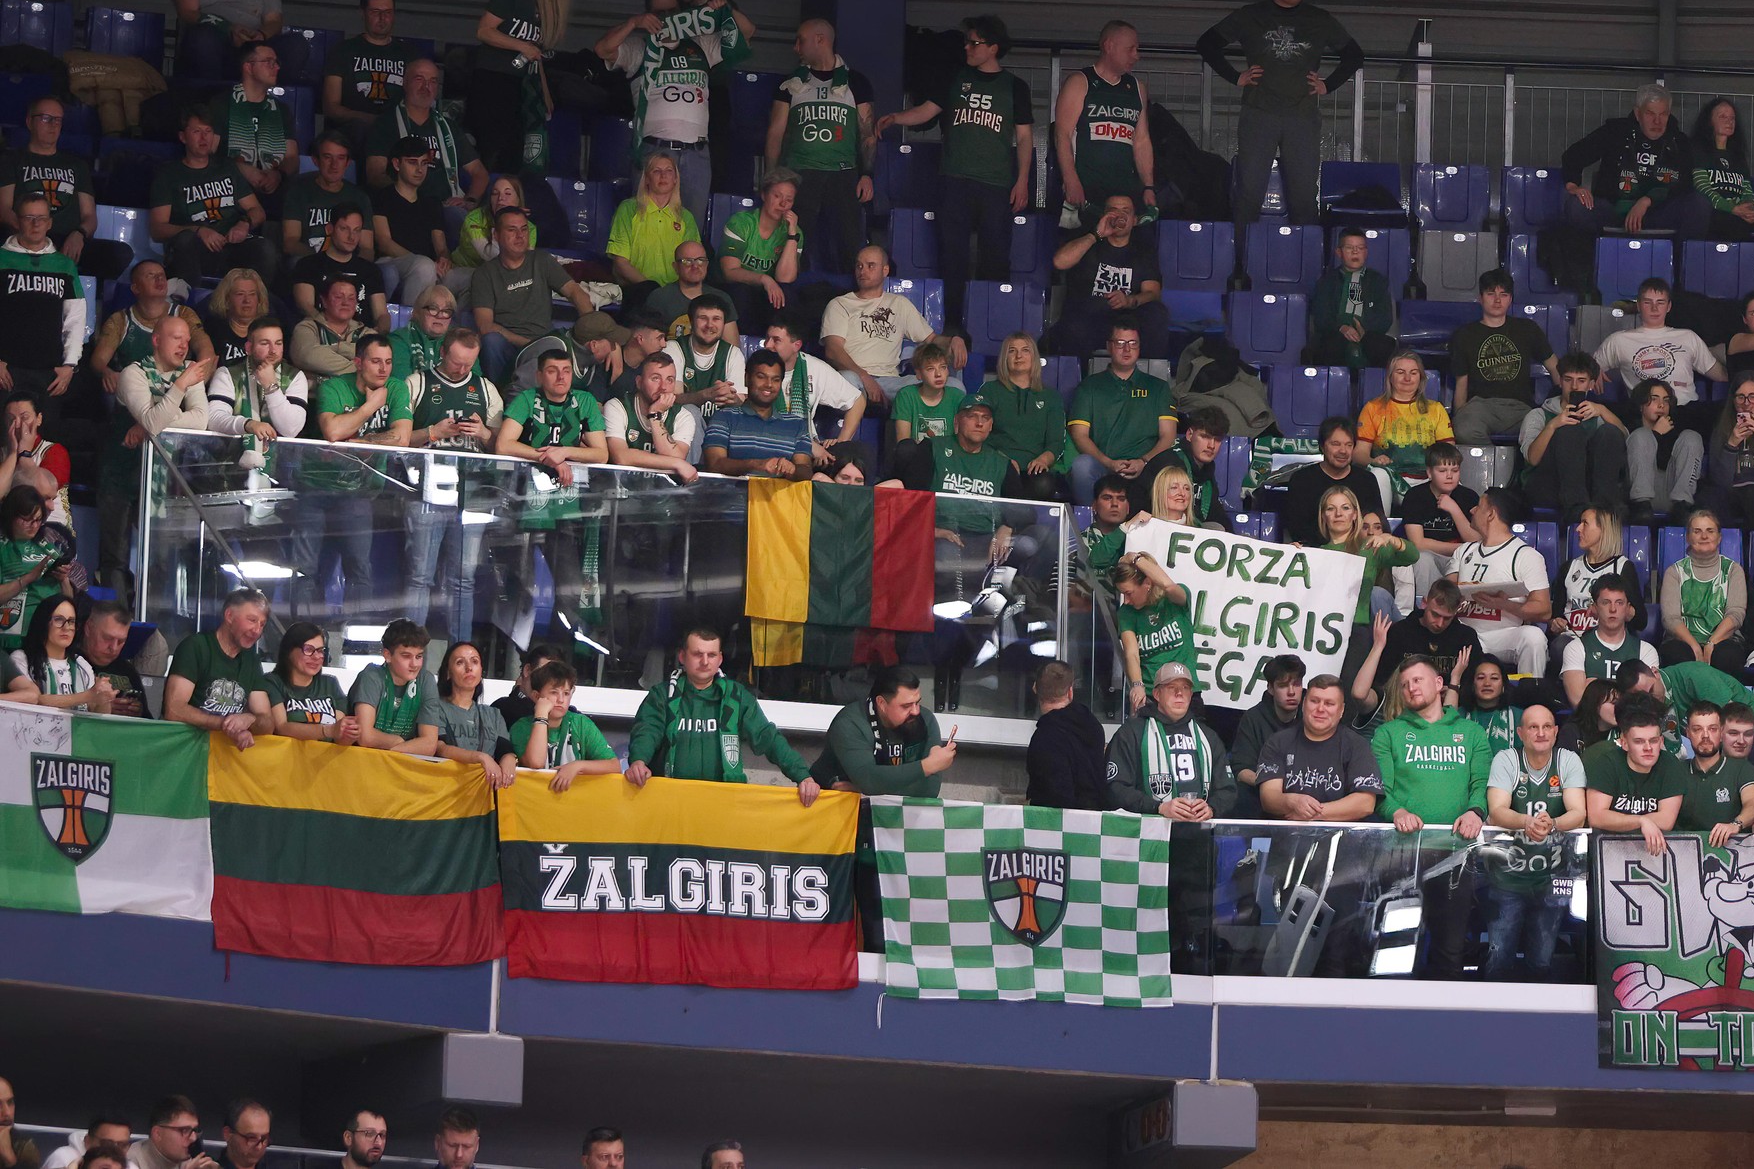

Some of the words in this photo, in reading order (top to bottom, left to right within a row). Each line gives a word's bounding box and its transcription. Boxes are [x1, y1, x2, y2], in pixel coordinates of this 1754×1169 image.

[671, 56, 687, 69] 09
[816, 86, 828, 100] 13
[969, 94, 993, 109] 55
[1095, 123, 1134, 140] OlyBe
[1477, 353, 1521, 369] GUINNESS
[1131, 389, 1148, 398] LTU
[1166, 531, 1312, 589] FORZA
[1471, 563, 1488, 582] 77
[1193, 590, 1345, 656] LGIRIS
[539, 843, 830, 922] ŽALGIRIS
[1552, 879, 1573, 887] GWB
[1552, 887, 1572, 895] KNS
[1611, 1009, 1680, 1067] ON
